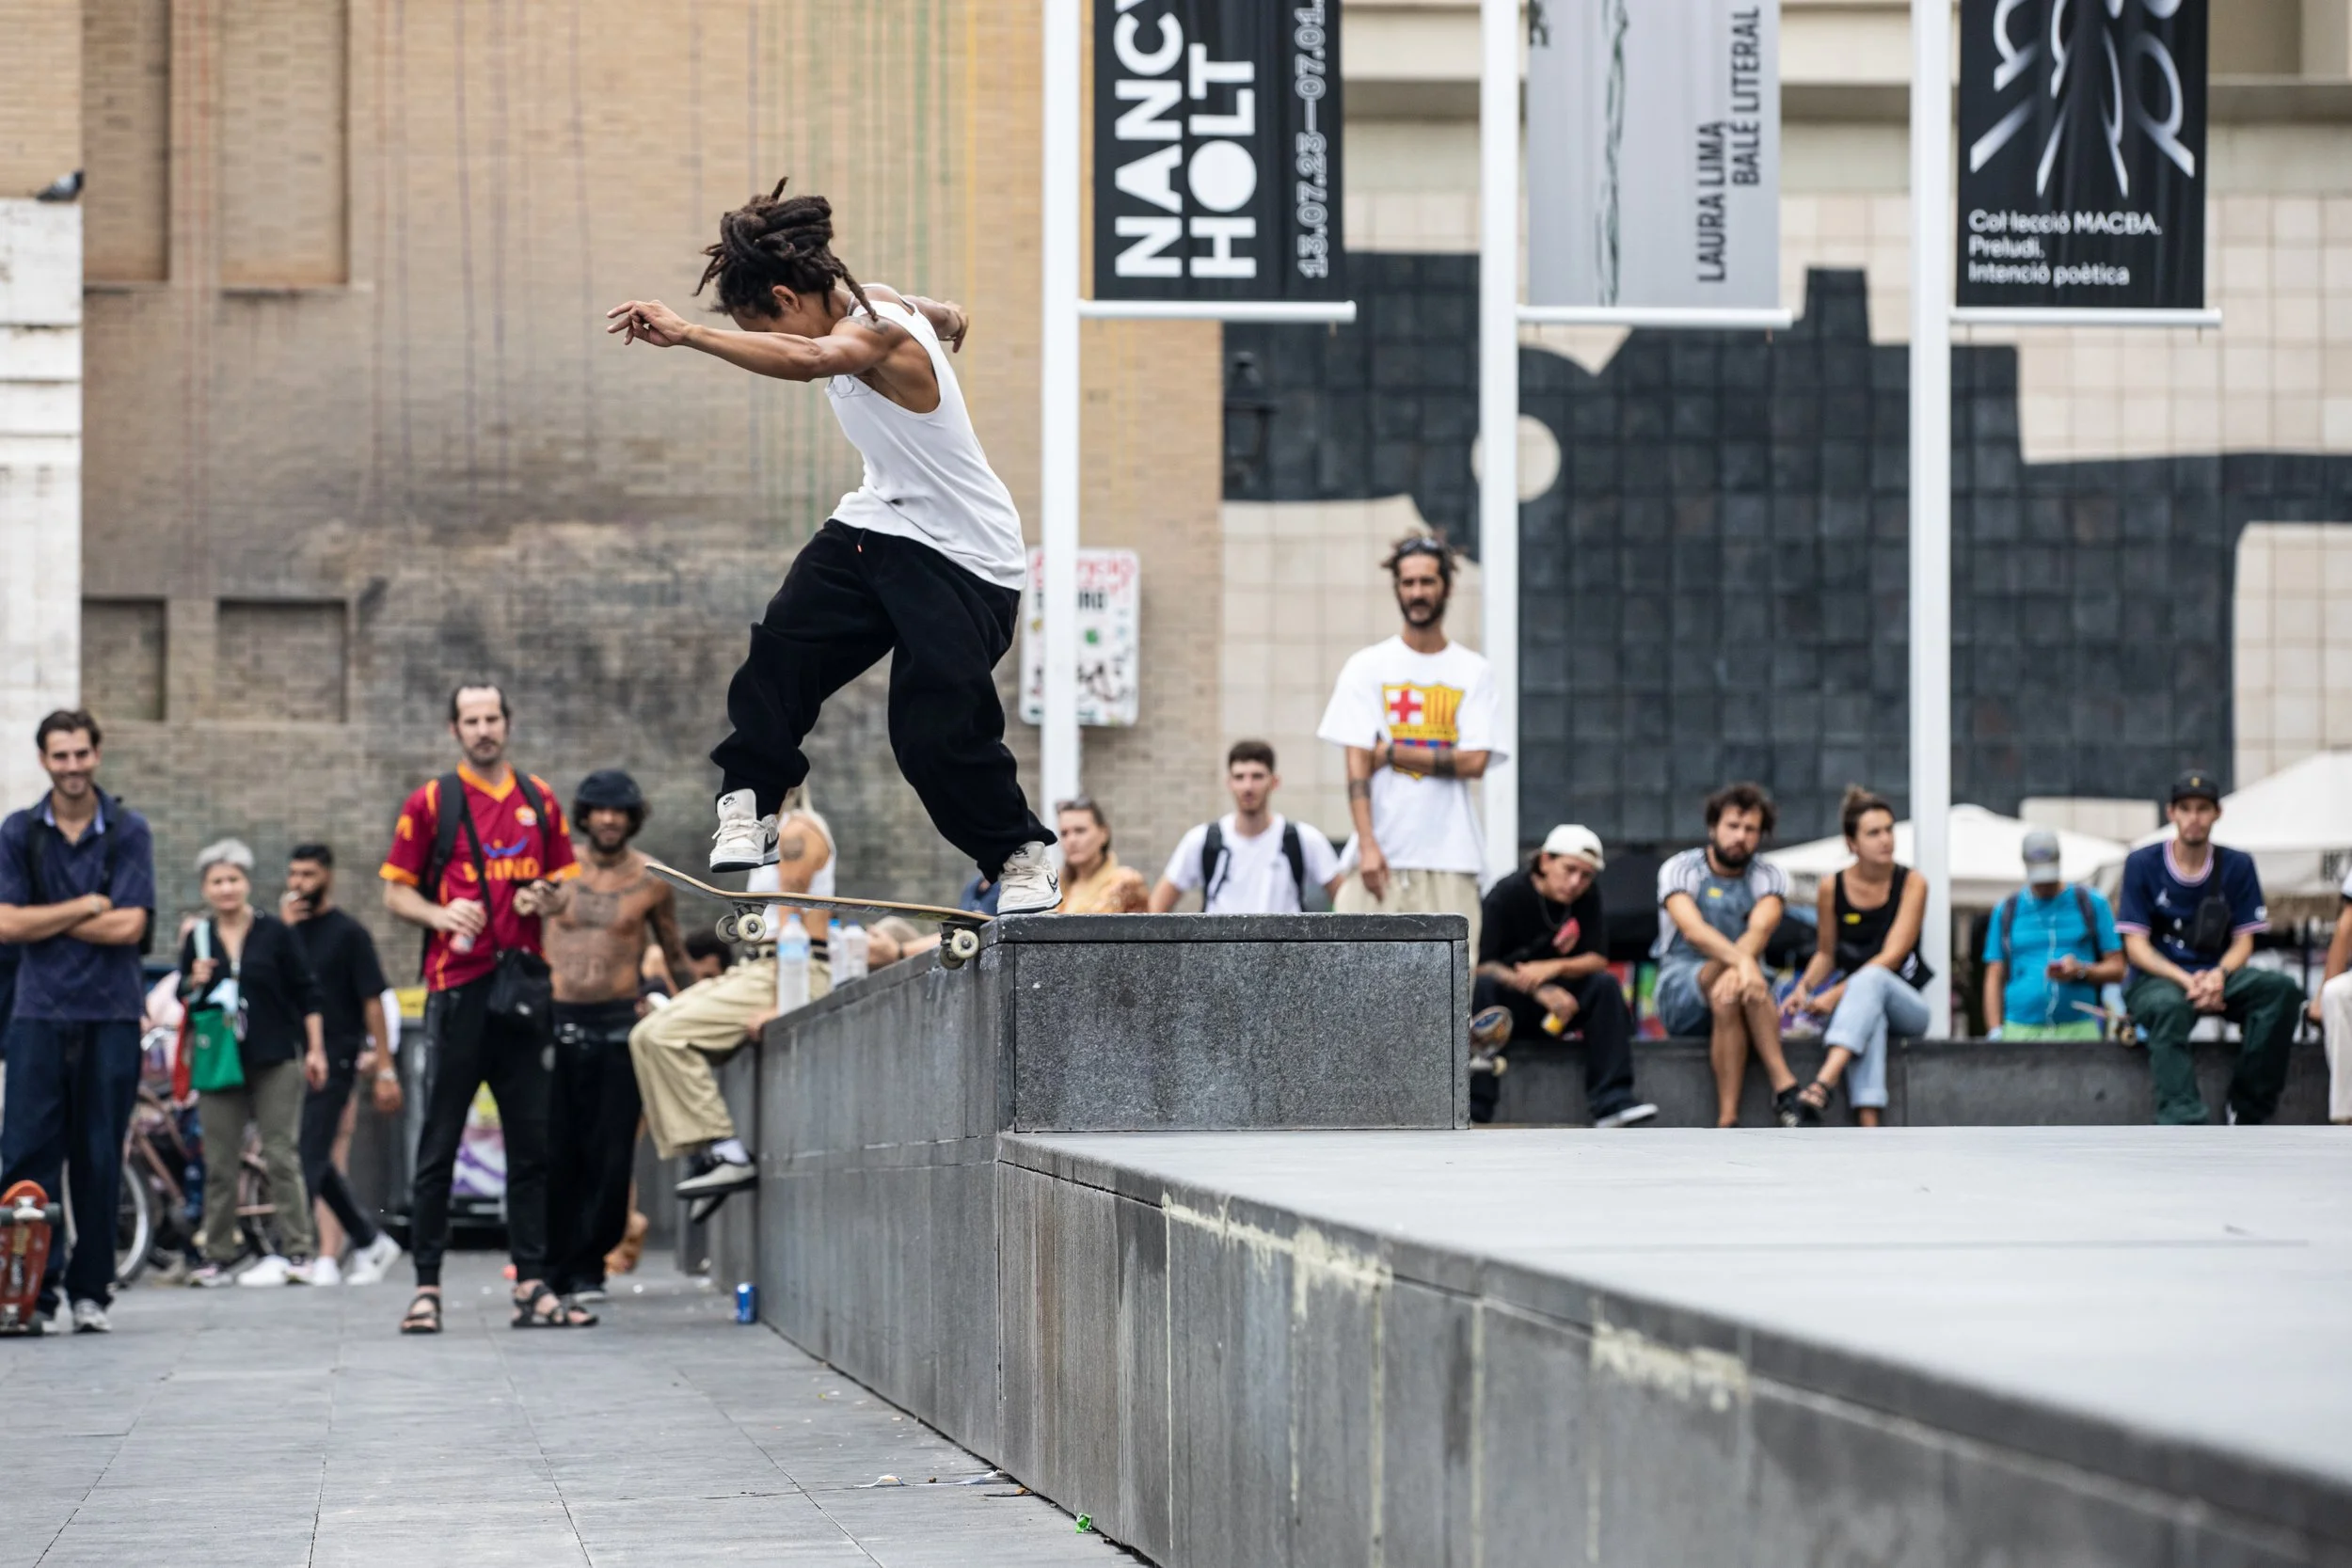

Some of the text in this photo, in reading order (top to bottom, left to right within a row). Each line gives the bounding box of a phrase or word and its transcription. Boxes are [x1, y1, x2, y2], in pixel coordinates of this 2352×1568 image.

[1114, 0, 1184, 277] NANC
[1187, 42, 1257, 278] HOLT
[1729, 6, 1760, 186] BALÉ LITERAL
[1697, 121, 1725, 282] LAURA LIMA
[1968, 260, 2051, 285] Intenció
